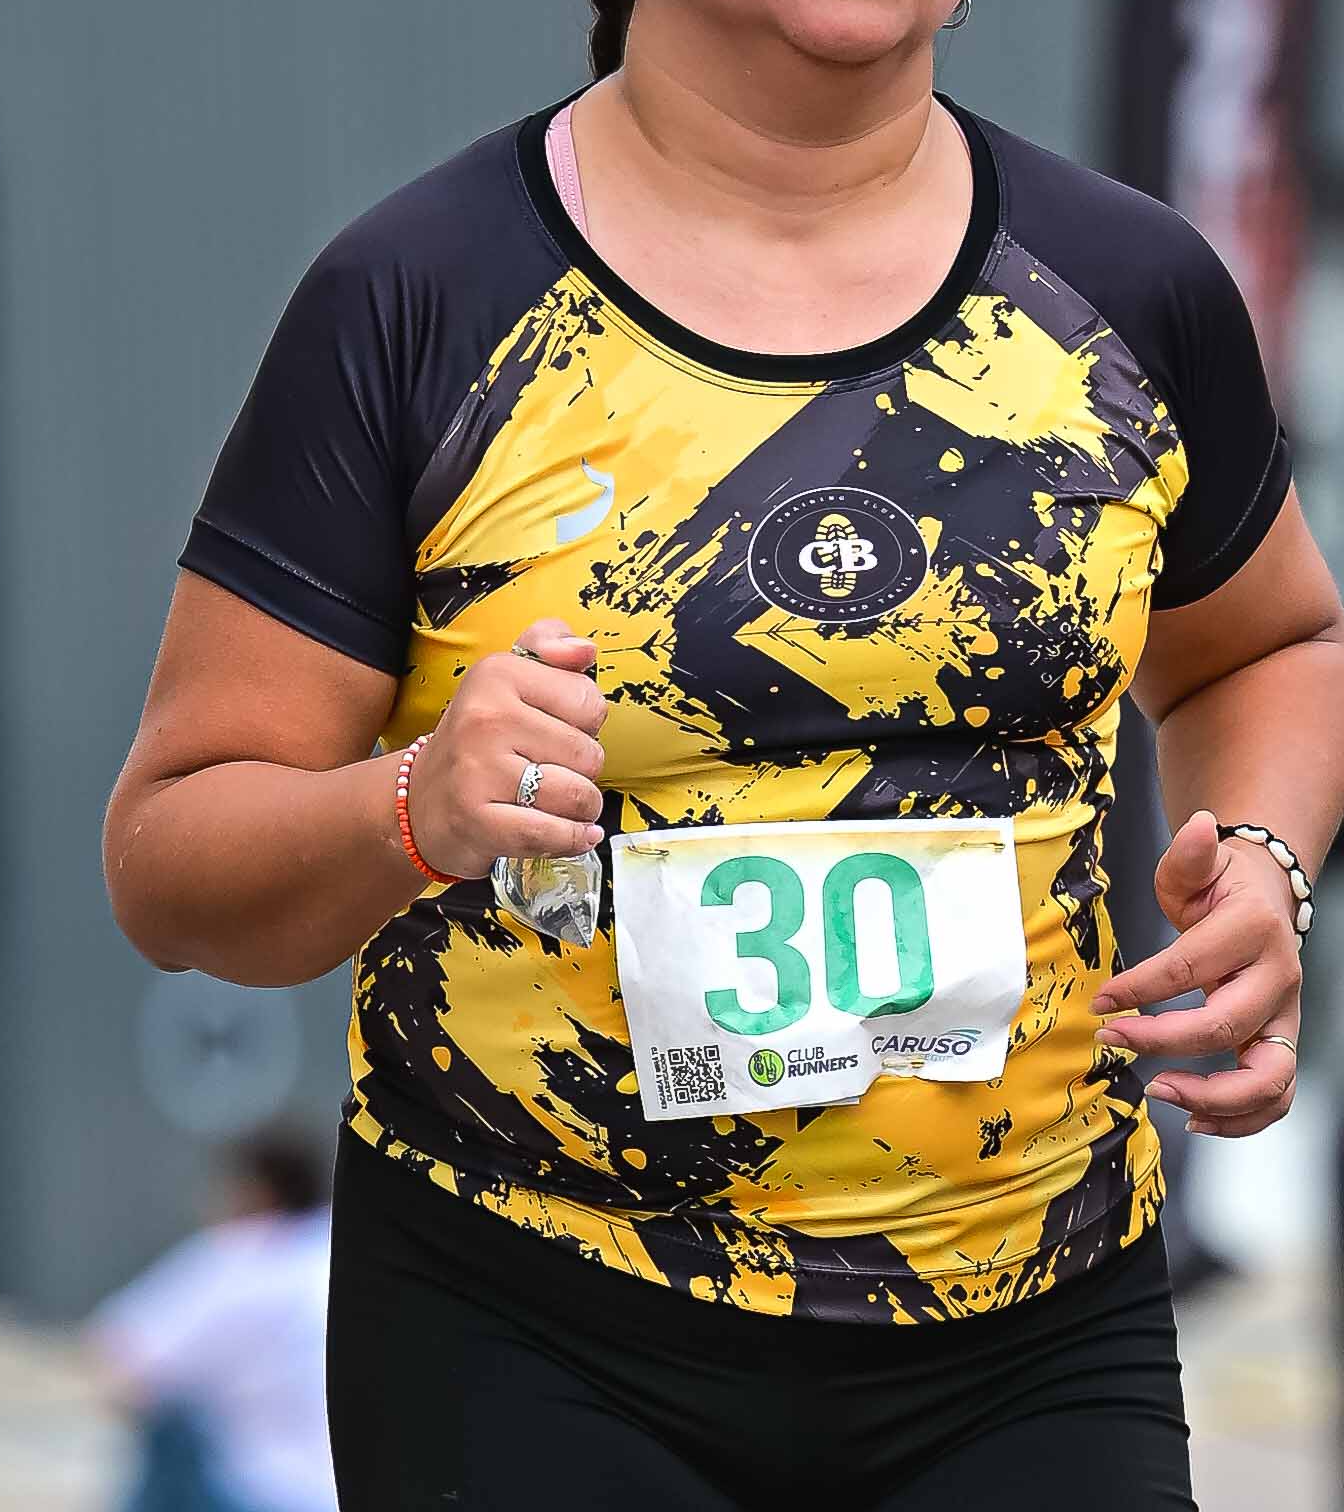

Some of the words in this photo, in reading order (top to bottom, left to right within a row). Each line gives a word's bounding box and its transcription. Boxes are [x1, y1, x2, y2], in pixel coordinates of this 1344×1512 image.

[798, 538, 878, 575] CB
[700, 852, 936, 1036] 30
[787, 1047, 825, 1062] CLUB
[871, 1035, 972, 1055] CARUSO
[788, 1054, 858, 1077] RUNNER'S
